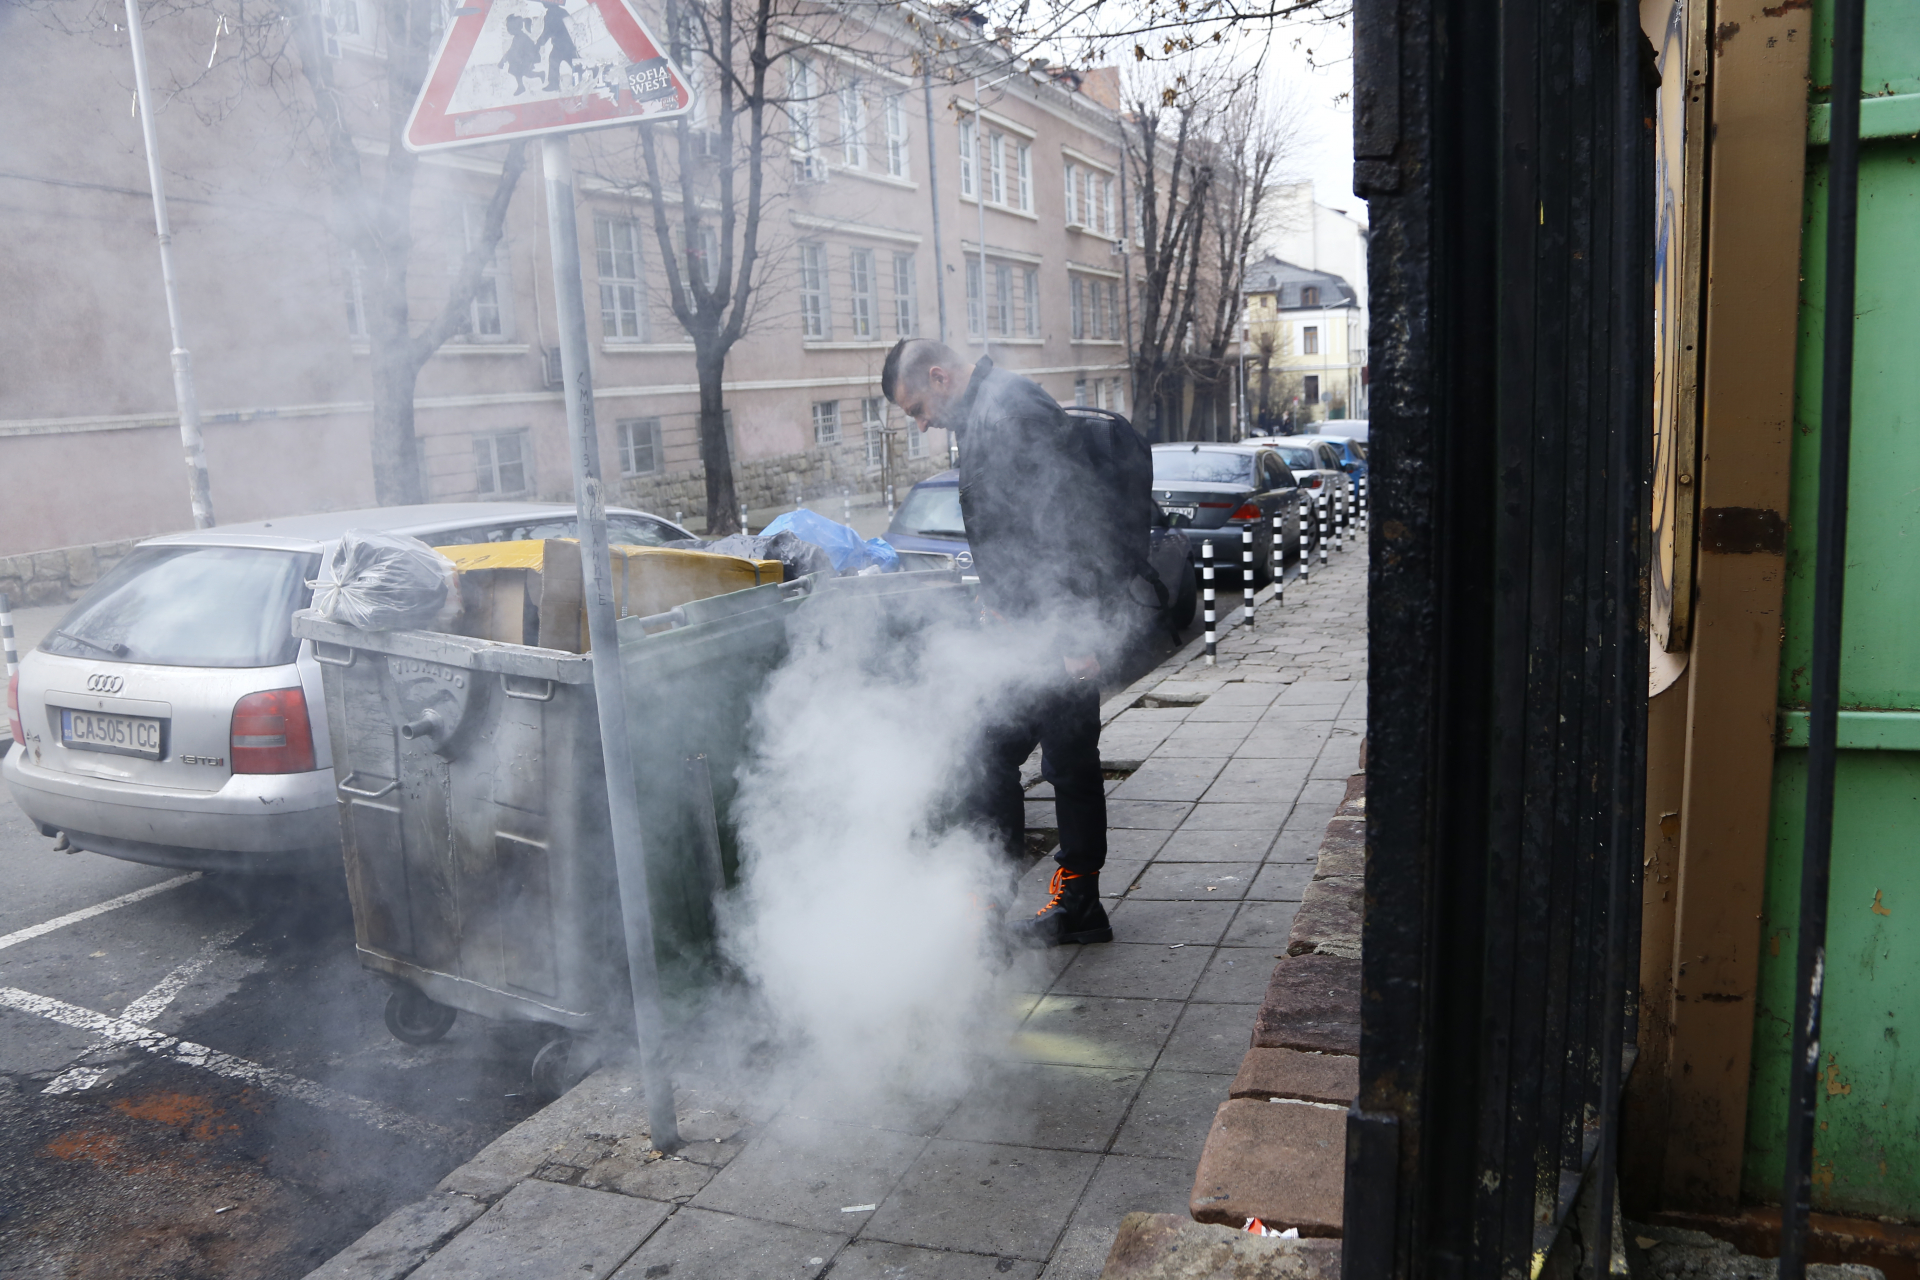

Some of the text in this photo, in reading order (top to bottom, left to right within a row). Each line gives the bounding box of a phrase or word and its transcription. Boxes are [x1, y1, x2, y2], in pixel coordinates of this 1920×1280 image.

[628, 65, 668, 86] SOFIA
[631, 76, 668, 95] WEST
[64, 729, 72, 737] BG
